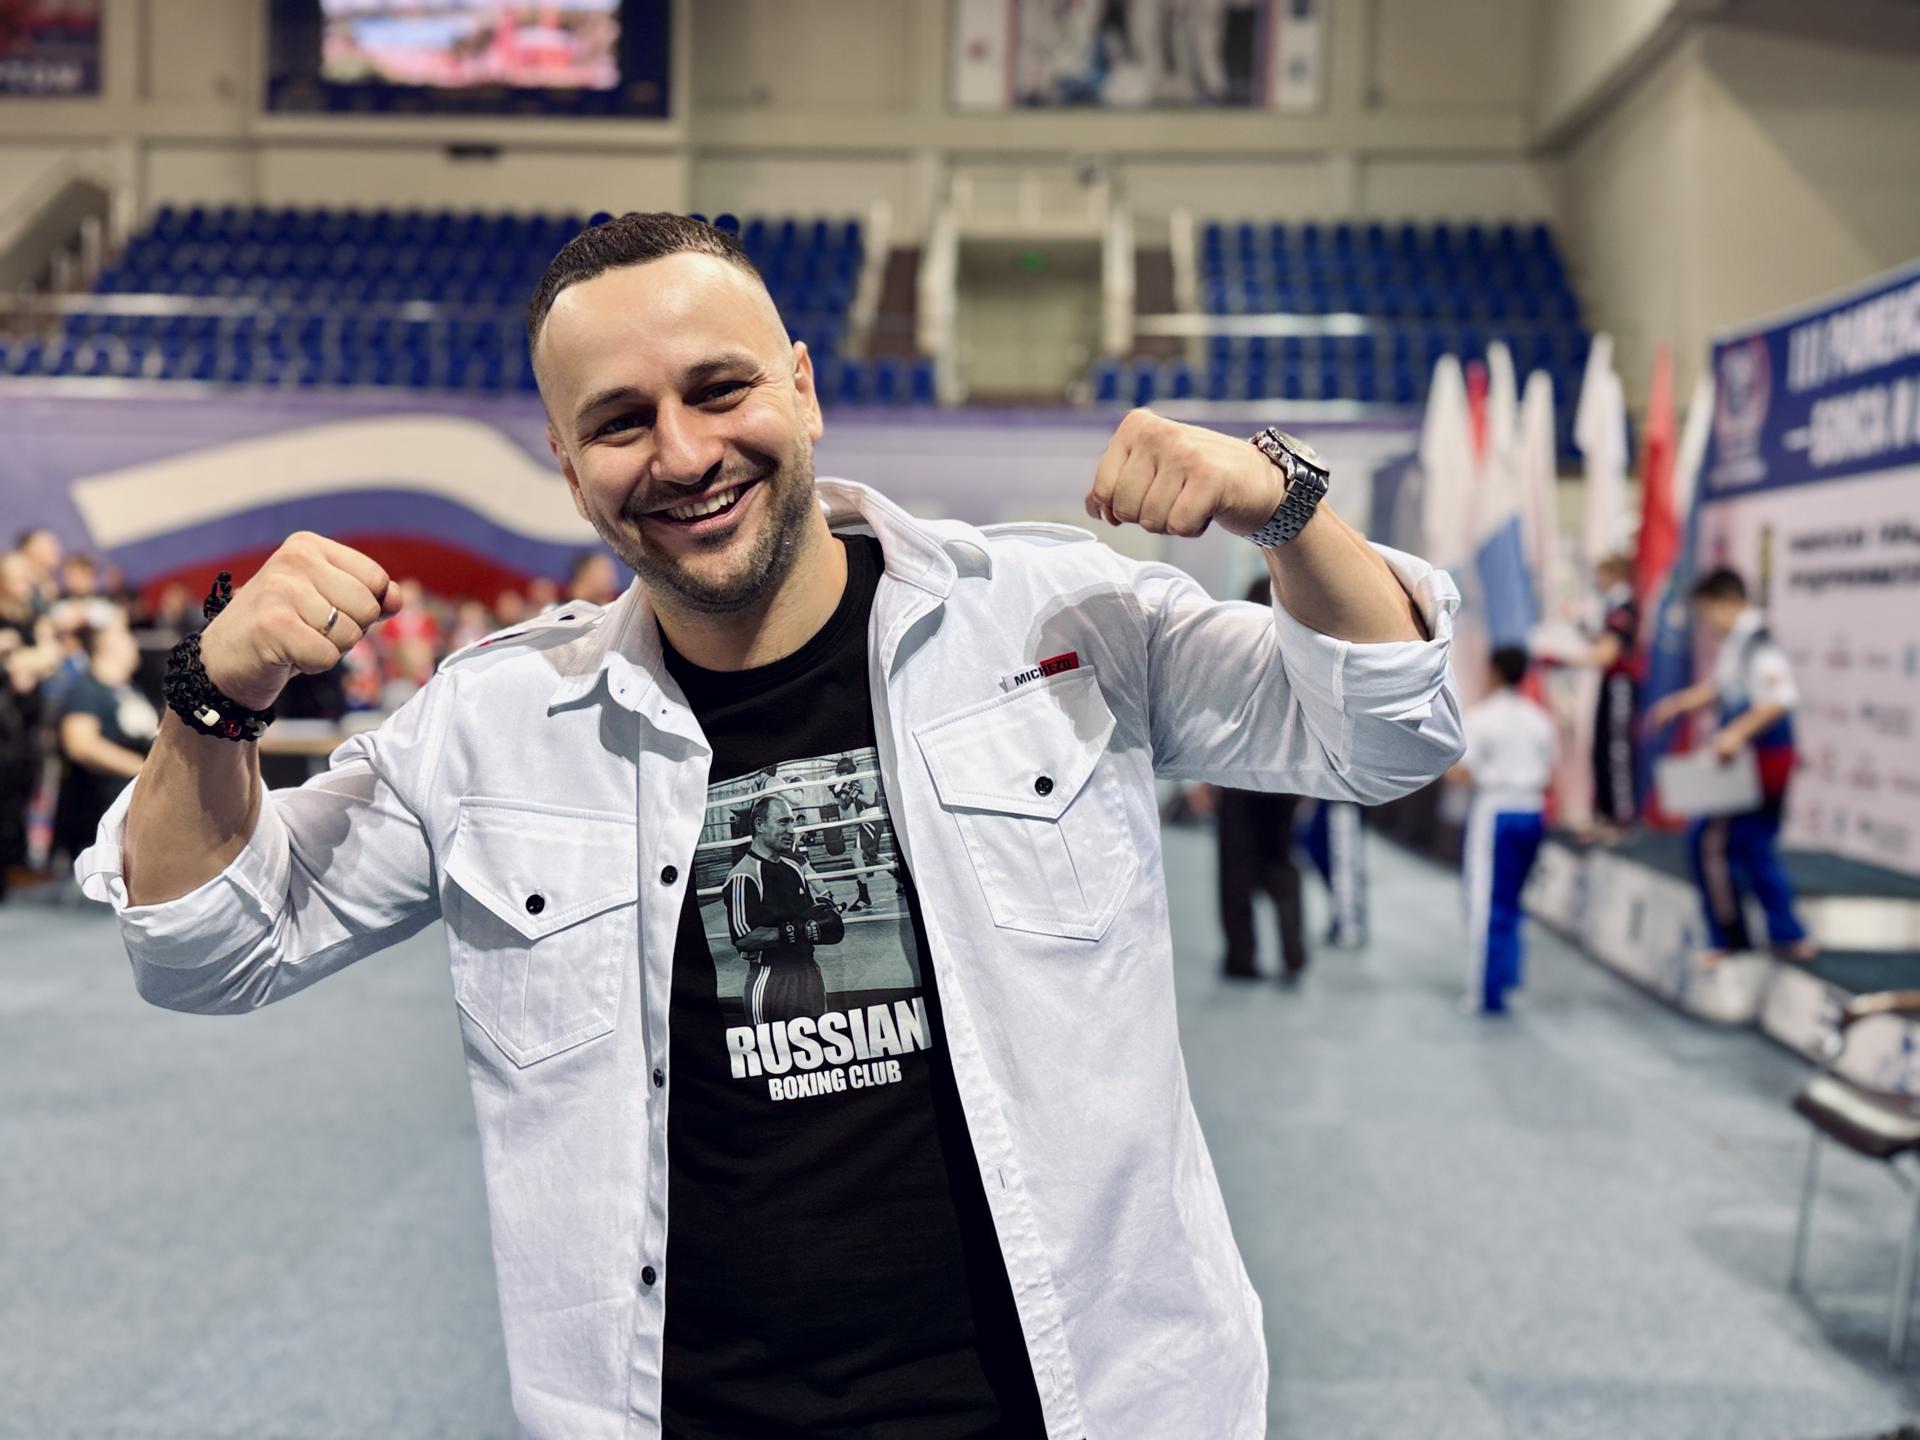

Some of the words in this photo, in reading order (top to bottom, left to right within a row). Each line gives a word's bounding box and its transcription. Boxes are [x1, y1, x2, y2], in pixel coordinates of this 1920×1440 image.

[726, 997, 932, 1078] RUSSIAN
[768, 1068, 848, 1101] BOXING
[848, 1059, 903, 1090] CLUB
